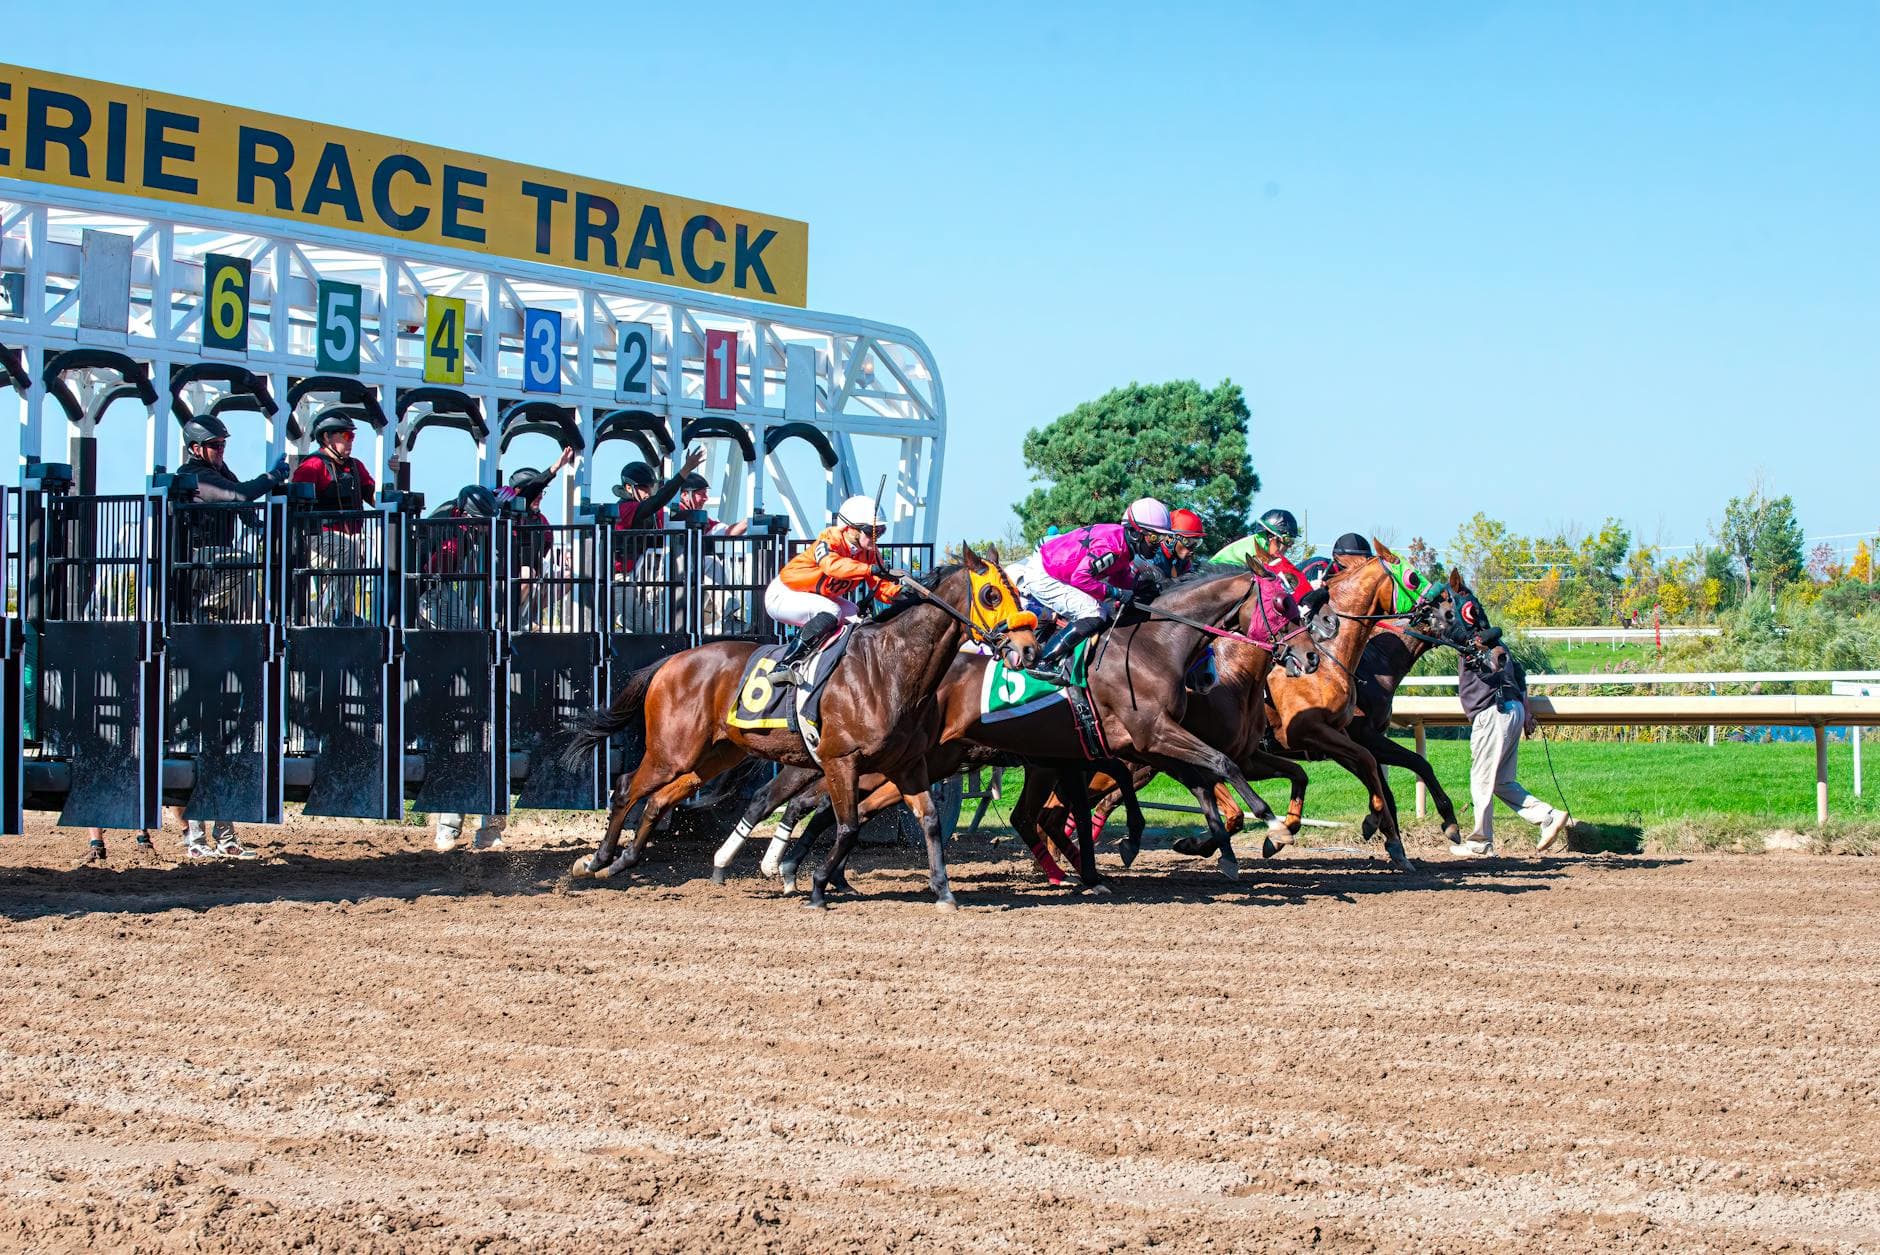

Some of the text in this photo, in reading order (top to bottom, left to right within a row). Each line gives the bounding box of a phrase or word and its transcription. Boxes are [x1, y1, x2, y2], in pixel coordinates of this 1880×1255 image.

[0, 82, 779, 295] RIE RACE TRACK
[211, 266, 244, 340] 6
[324, 293, 355, 362] 5
[430, 308, 460, 373] 4
[530, 318, 557, 385] 3
[622, 330, 648, 394] 2
[712, 339, 728, 400] 1
[1094, 552, 1115, 573] 5
[741, 657, 777, 713] 6
